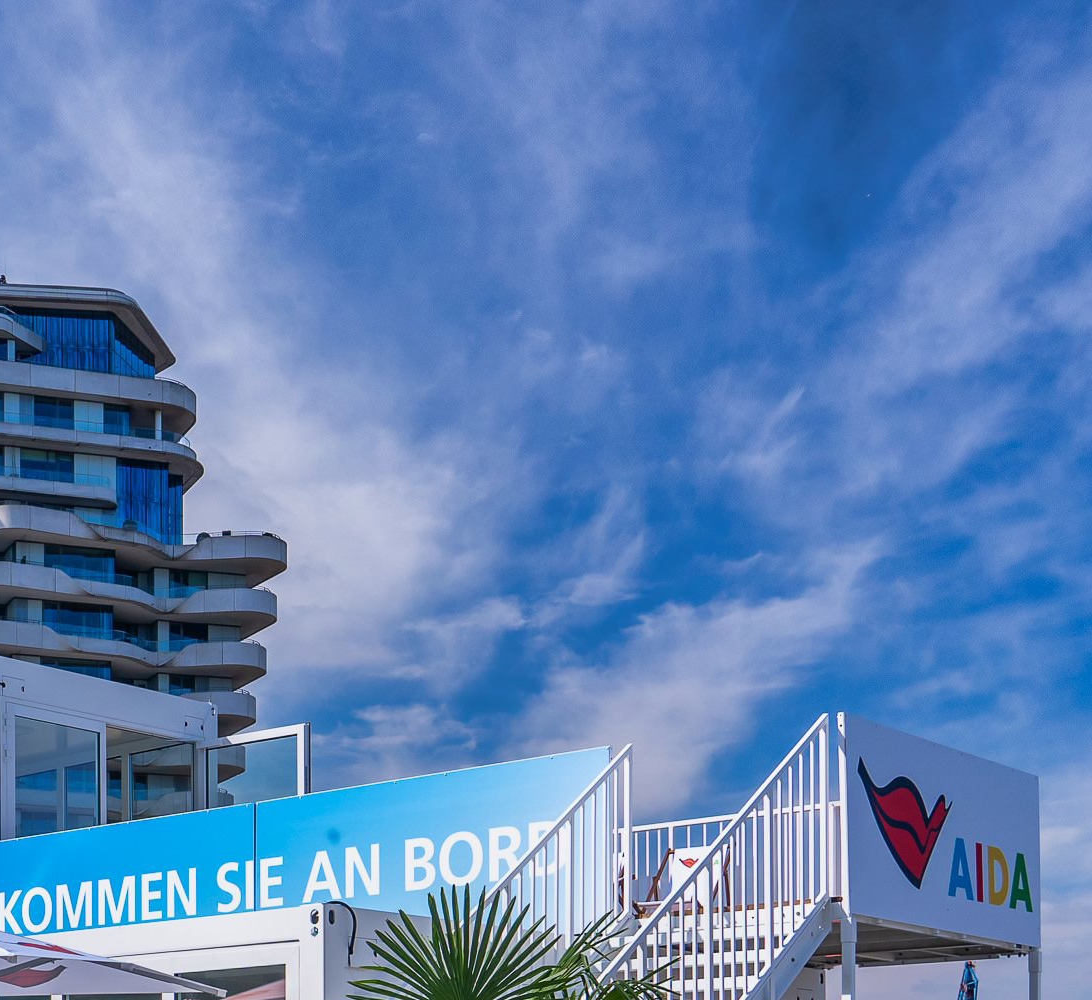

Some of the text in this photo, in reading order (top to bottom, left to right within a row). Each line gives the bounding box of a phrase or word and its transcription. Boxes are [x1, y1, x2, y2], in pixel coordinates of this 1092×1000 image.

[217, 856, 284, 913] SIE
[302, 843, 380, 903] AN
[404, 820, 569, 892] BORD
[948, 837, 1033, 913] AIDA
